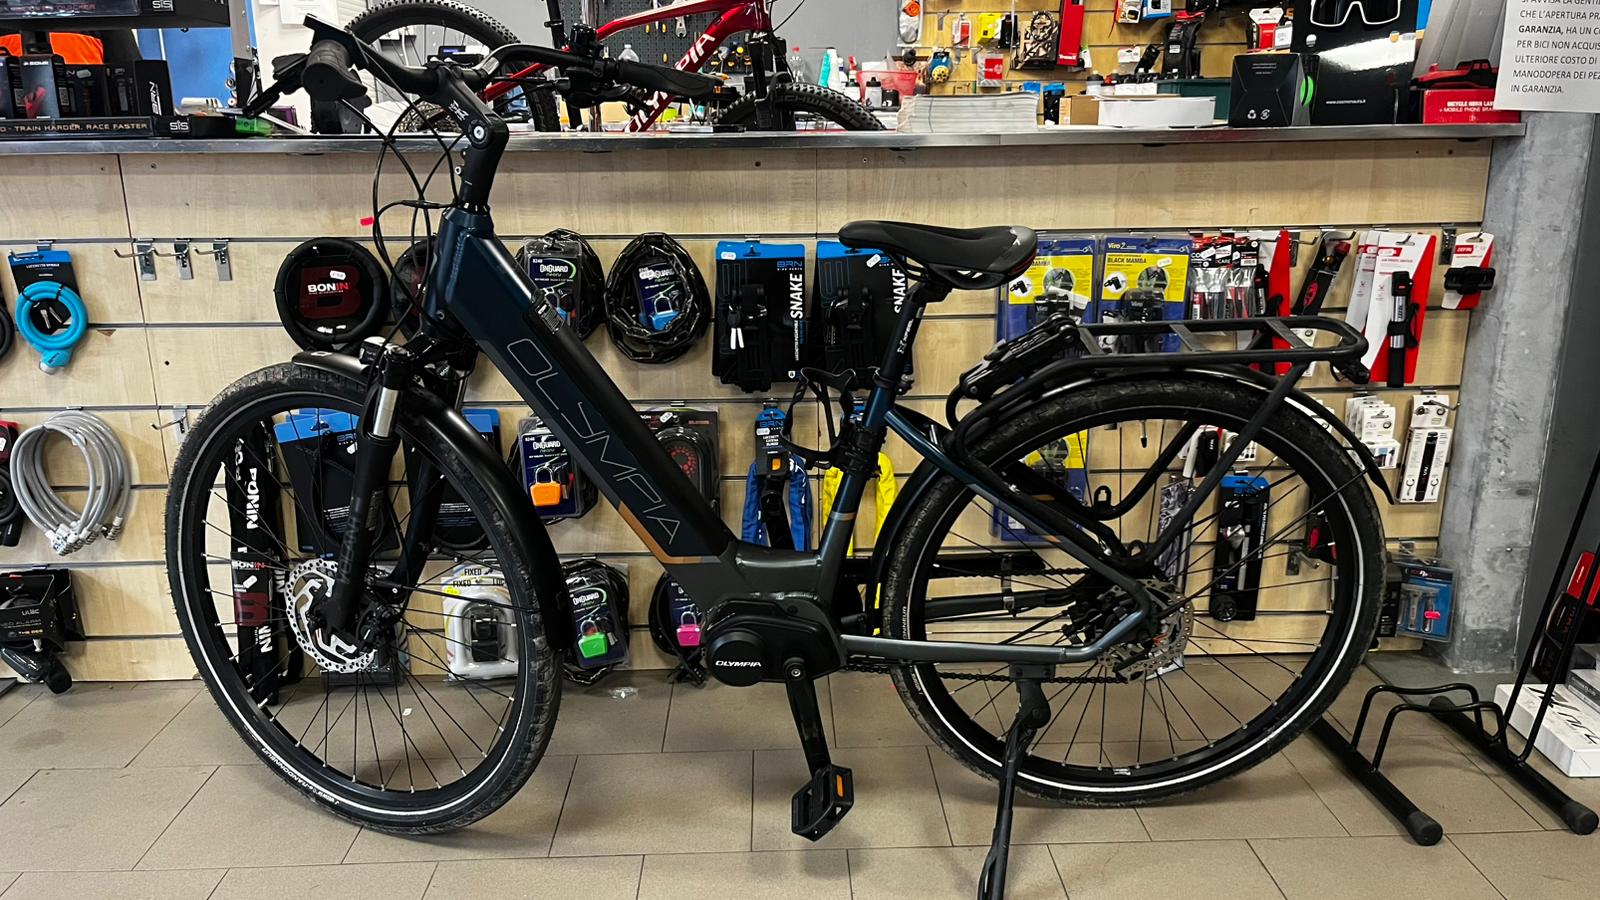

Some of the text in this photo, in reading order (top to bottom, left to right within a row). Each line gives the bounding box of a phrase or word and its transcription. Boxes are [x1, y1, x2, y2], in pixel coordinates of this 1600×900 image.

[1519, 10, 1537, 18] CHE
[1538, 11, 1587, 20] L'APERTURA
[1518, 25, 1564, 35] GARANZIA,
[1516, 40, 1532, 48] PER
[1534, 41, 1550, 49] BICI
[1551, 41, 1570, 49] NON
[1515, 55, 1598, 65] ULTERIORE COSTO DI
[1512, 70, 1572, 79] MANODOPERA
[1573, 71, 1587, 80] DEI
[1510, 84, 1565, 94] IN GARANZIA.
[307, 283, 349, 293] BONIN
[789, 273, 804, 319] SNAKE
[507, 338, 681, 545] OLYMPIA
[464, 568, 482, 576] FIXED
[452, 580, 472, 588] FIXED
[715, 660, 762, 668] OLYMPIA
